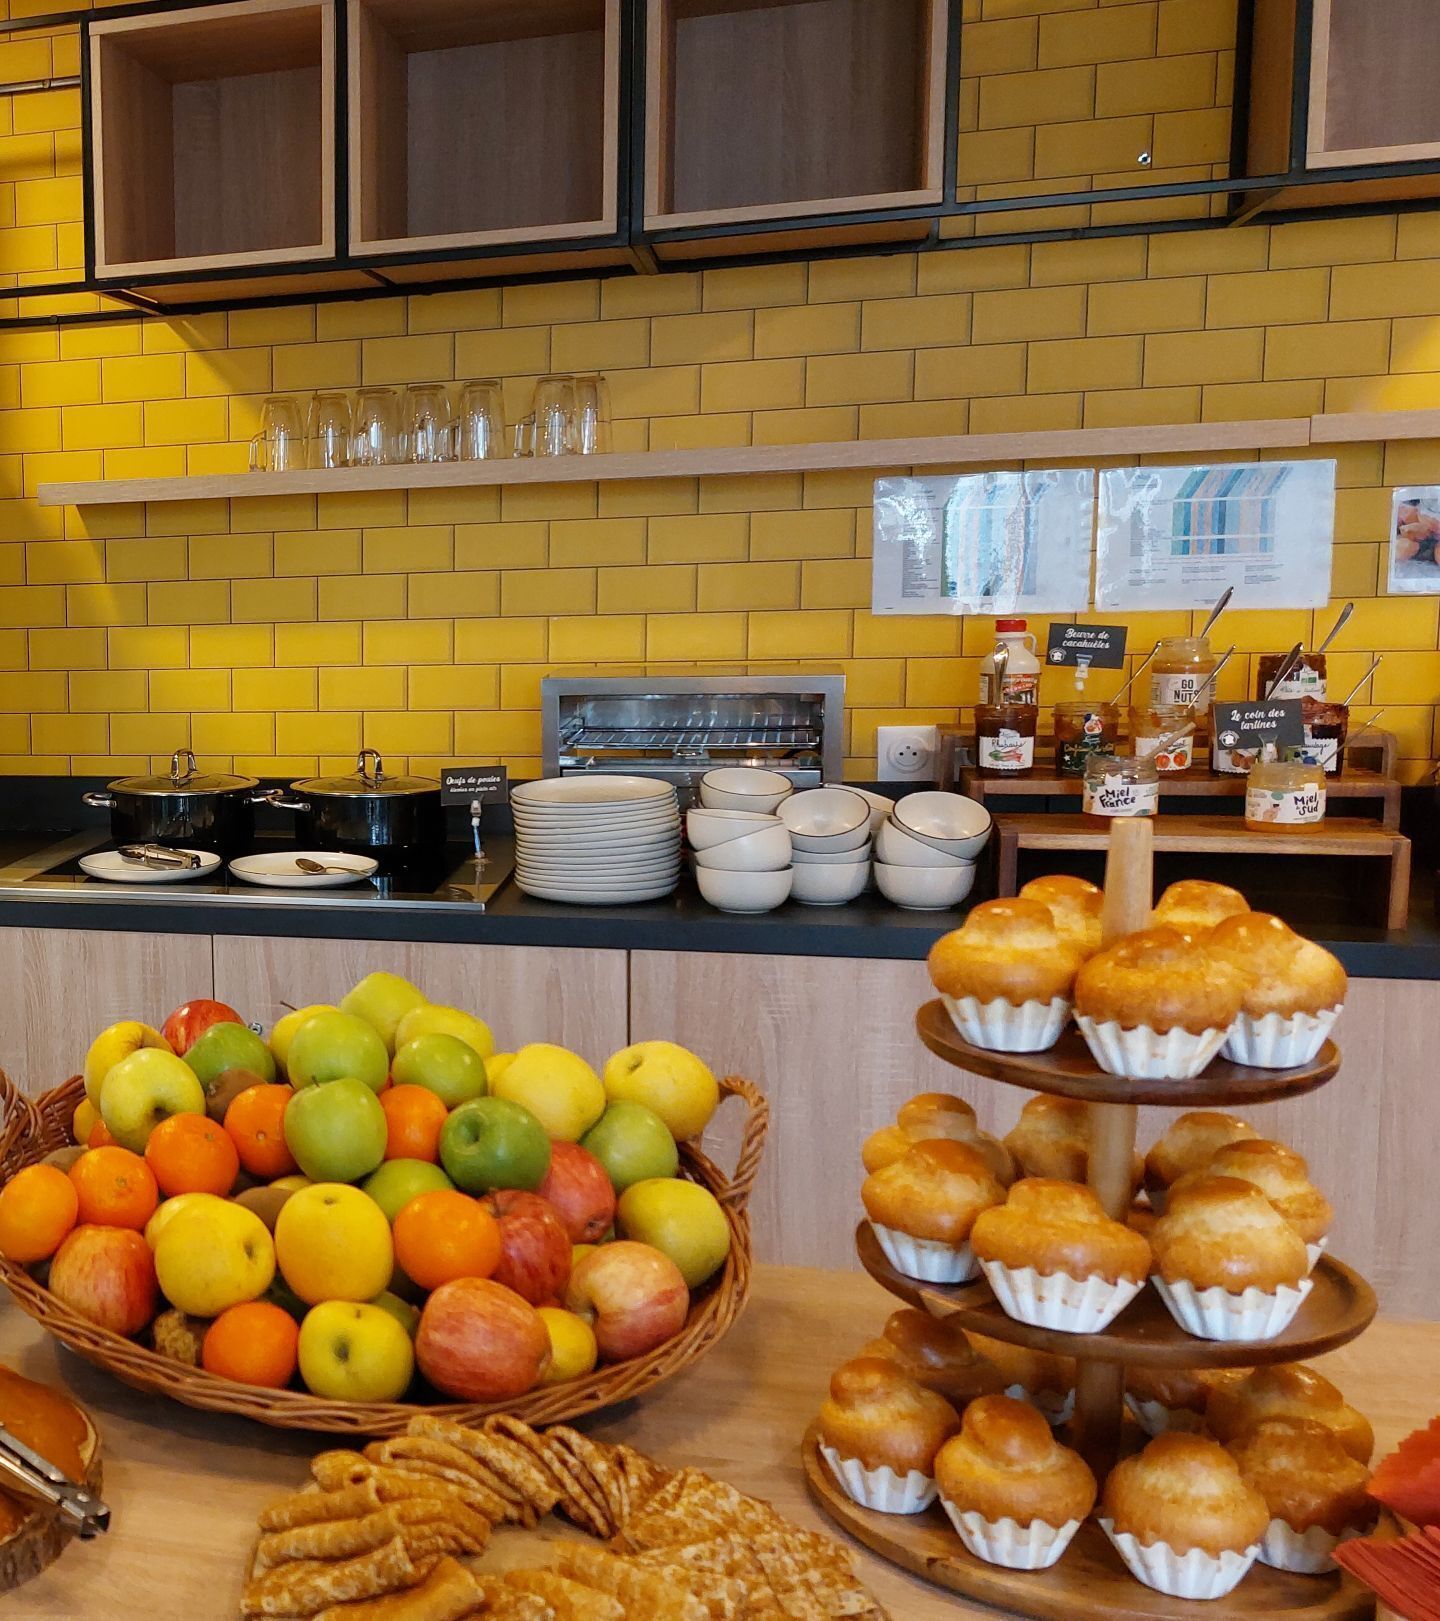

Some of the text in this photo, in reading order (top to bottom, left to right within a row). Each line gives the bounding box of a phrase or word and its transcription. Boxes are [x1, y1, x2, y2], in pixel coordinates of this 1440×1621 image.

[1064, 628, 1110, 639] Beurre de
[1061, 639, 1111, 649] cacahuètes
[1181, 679, 1194, 690] GO
[1231, 708, 1286, 721] Le coin des
[1240, 719, 1277, 730] tartines
[466, 776, 477, 784] de
[1105, 787, 1130, 799] Miel
[1293, 791, 1318, 805] Miel
[1099, 795, 1137, 808] France
